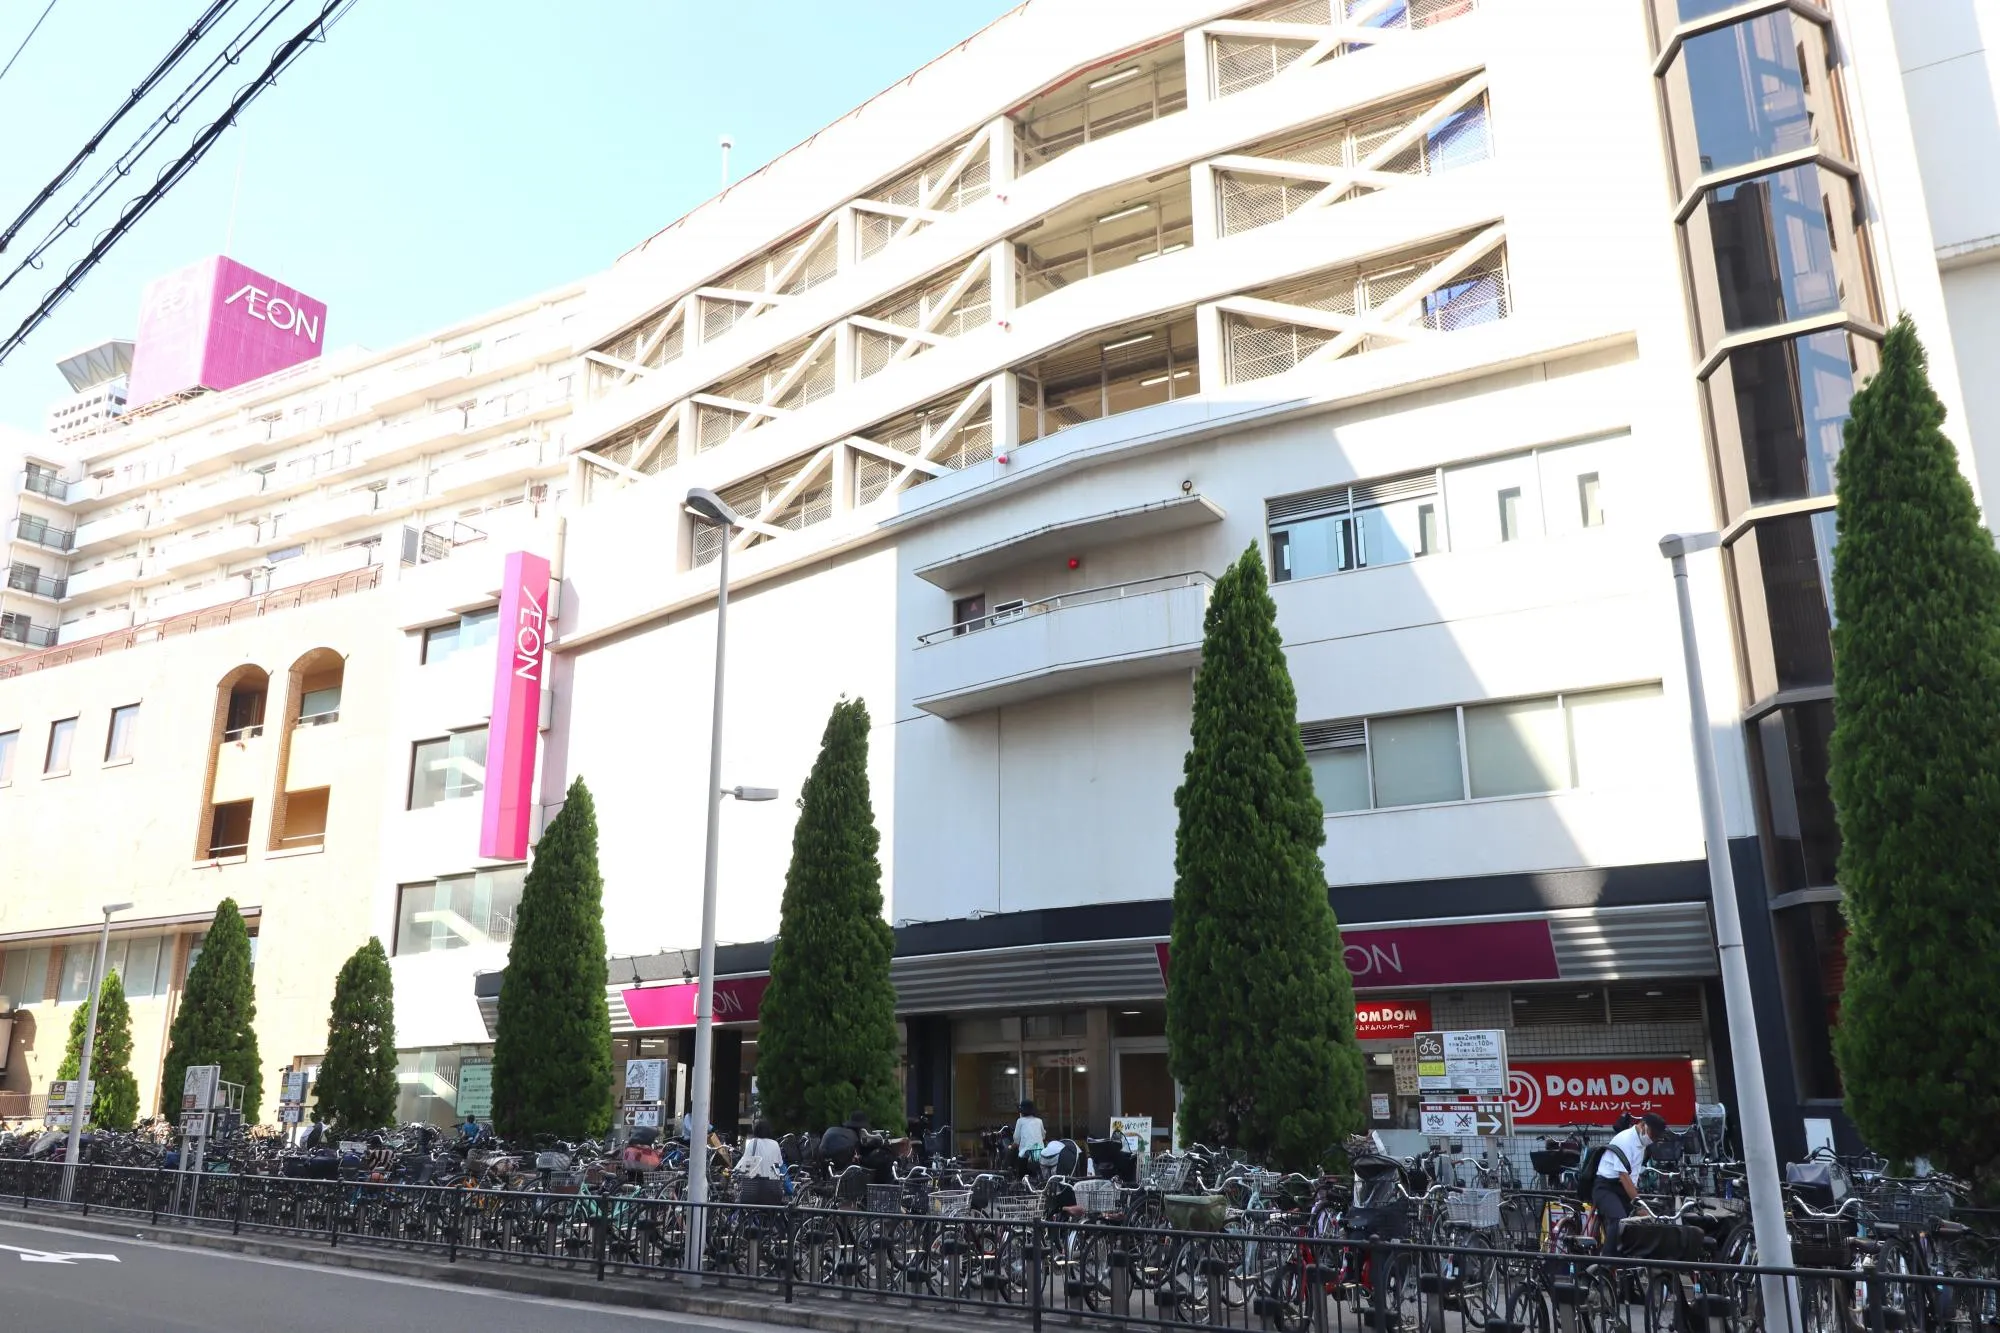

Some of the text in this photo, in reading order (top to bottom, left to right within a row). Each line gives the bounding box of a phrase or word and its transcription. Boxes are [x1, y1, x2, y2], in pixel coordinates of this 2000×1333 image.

[1355, 1008, 1418, 1023] OMDOM
[1545, 1073, 1676, 1097] DOMDOM
[1559, 1101, 1663, 1112] ドムドムハンバーガー
